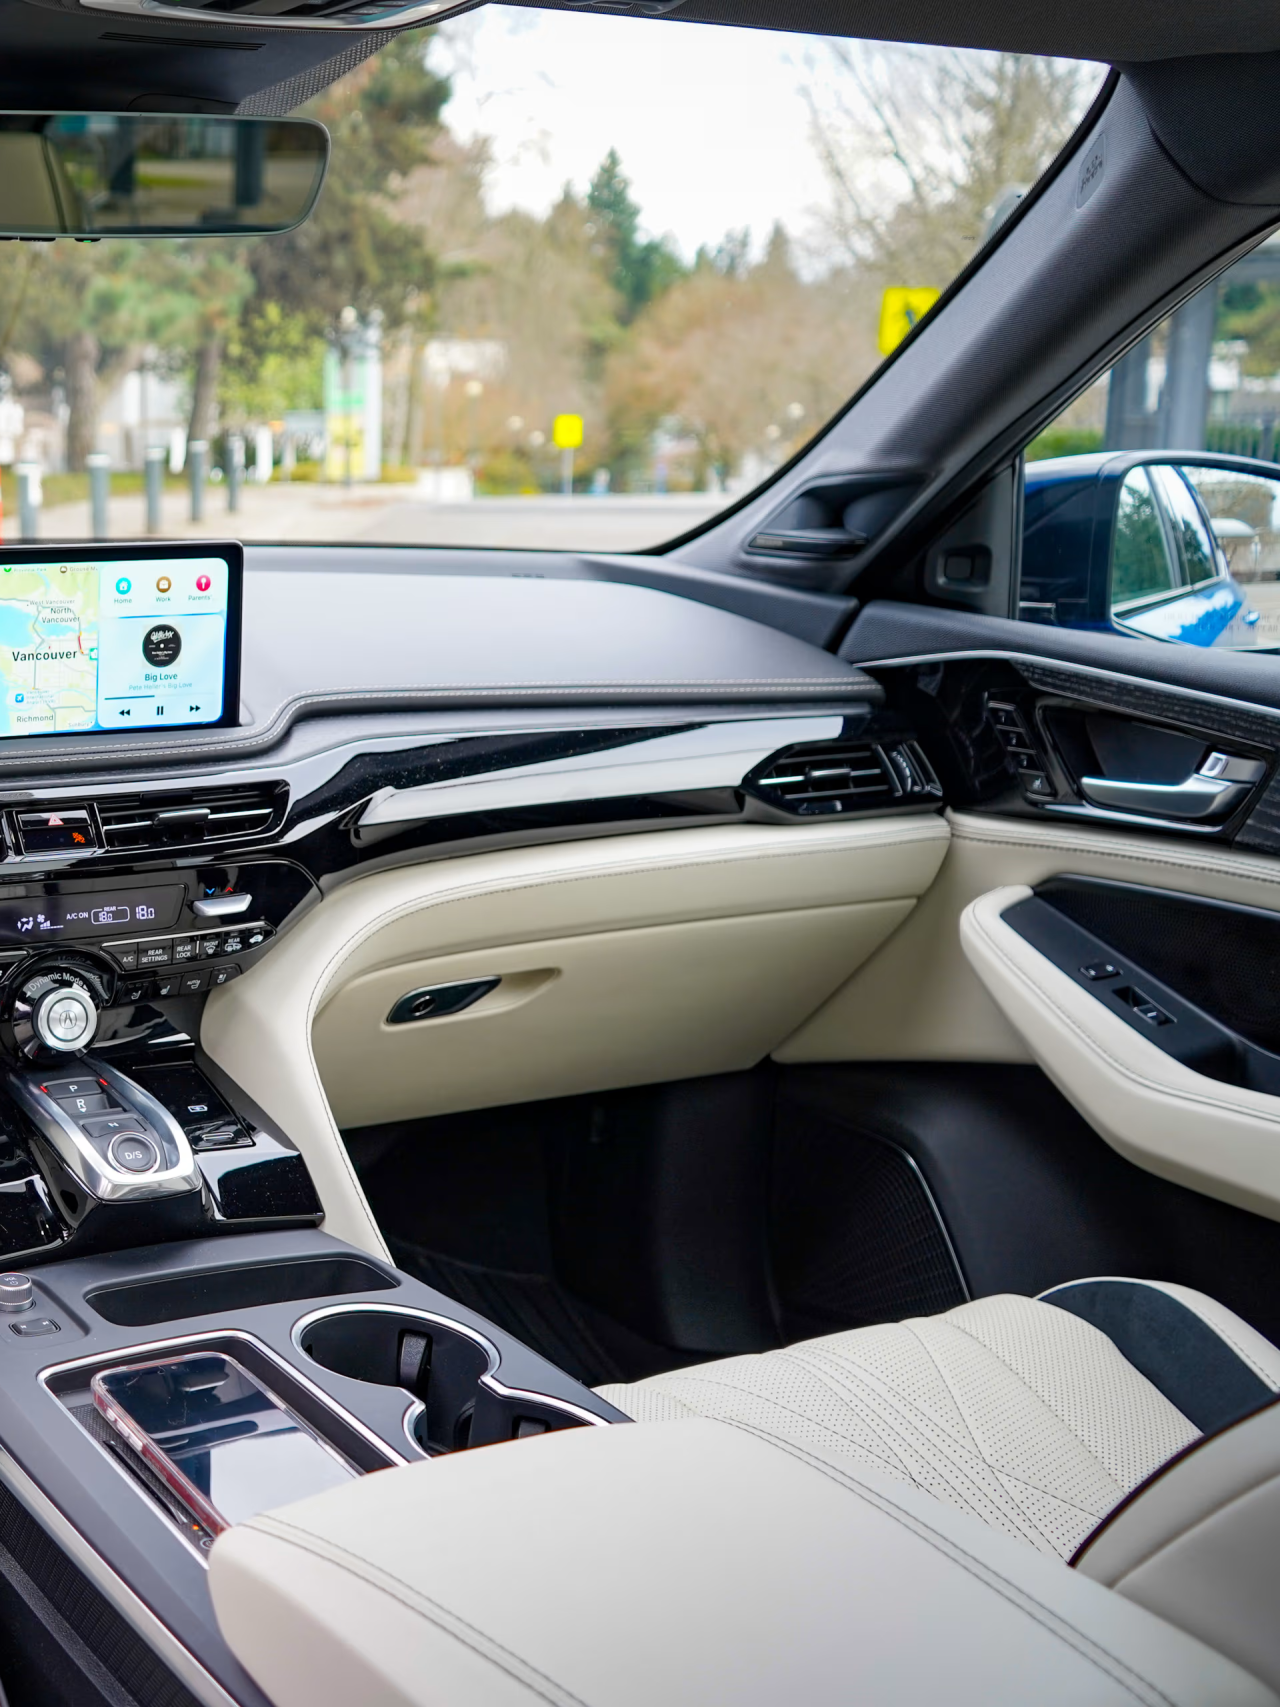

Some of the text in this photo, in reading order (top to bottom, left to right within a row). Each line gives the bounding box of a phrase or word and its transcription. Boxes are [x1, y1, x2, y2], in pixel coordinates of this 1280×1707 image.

[41, 616, 81, 624] Vancouver
[12, 650, 78, 662] Vancouver
[144, 672, 178, 682] Big Love
[167, 682, 178, 690] Big
[16, 714, 54, 723] Richmond
[66, 911, 89, 920] A/C ON
[135, 905, 155, 920] 18.0
[122, 955, 134, 963] A/C
[141, 954, 168, 963] SETTINGS
[176, 951, 191, 959] LOCK
[28, 972, 62, 991] Dynamic
[62, 972, 84, 987] Mode
[76, 1098, 86, 1109] R
[124, 1151, 143, 1160] D/S
